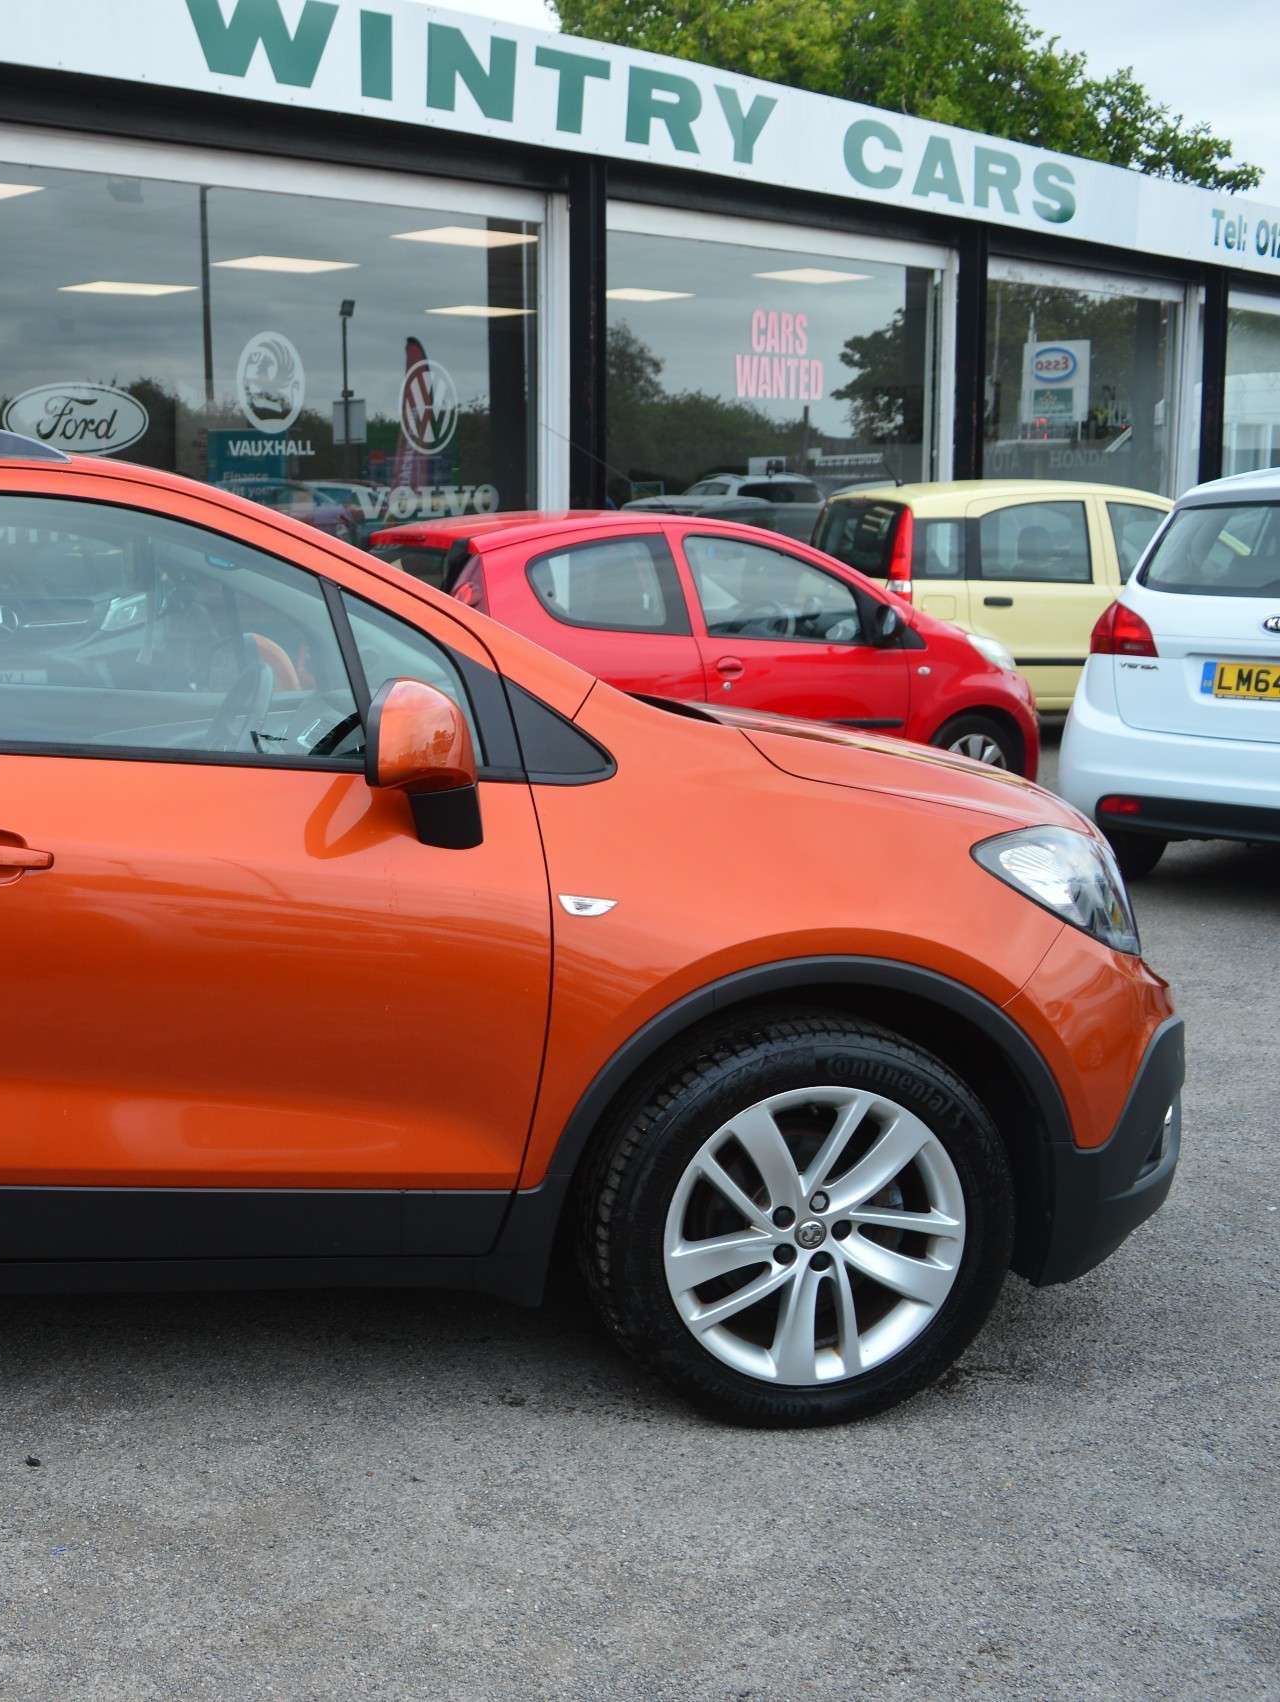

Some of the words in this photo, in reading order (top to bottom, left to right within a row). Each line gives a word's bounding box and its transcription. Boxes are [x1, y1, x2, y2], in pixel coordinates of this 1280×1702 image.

[187, 0, 778, 164] WINTRY
[842, 118, 1077, 224] CARS
[1212, 207, 1247, 252] Tel:
[1256, 219, 1280, 259] 01
[751, 308, 808, 356] CARS
[735, 354, 823, 400] WANTED
[36, 395, 118, 440] Ford
[228, 439, 316, 456] VAUXHALL
[1048, 449, 1109, 469] HONDA
[351, 484, 499, 520] VOLVO
[826, 1052, 954, 1114] Continental
